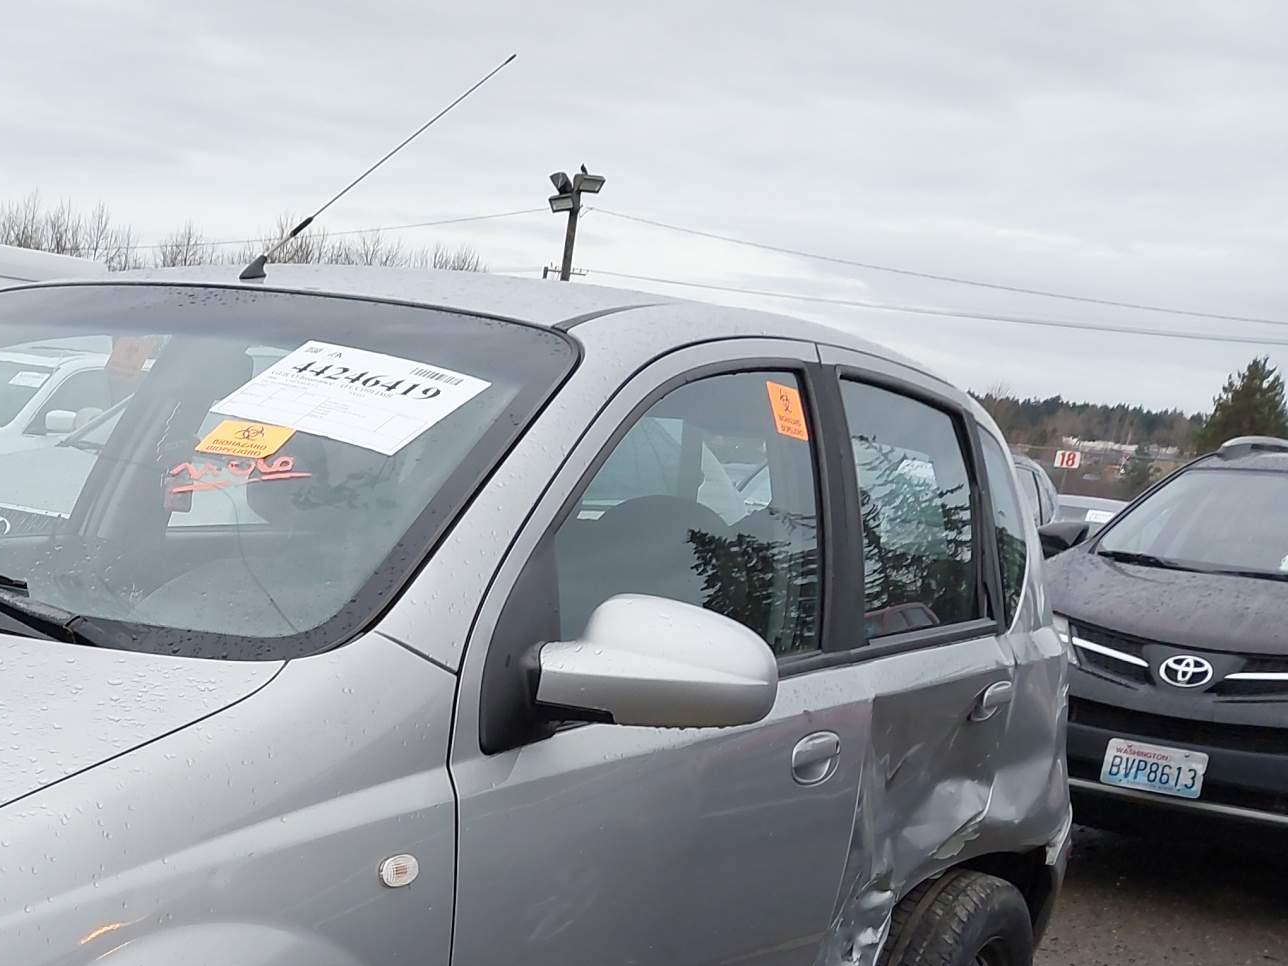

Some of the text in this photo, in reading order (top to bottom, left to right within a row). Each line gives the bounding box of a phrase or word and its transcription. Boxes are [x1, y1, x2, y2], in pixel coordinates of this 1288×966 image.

[291, 360, 441, 400] 44246419
[1059, 451, 1077, 467] 18
[1115, 746, 1169, 761] WASHINGTON
[1108, 754, 1197, 790] BVP8613
